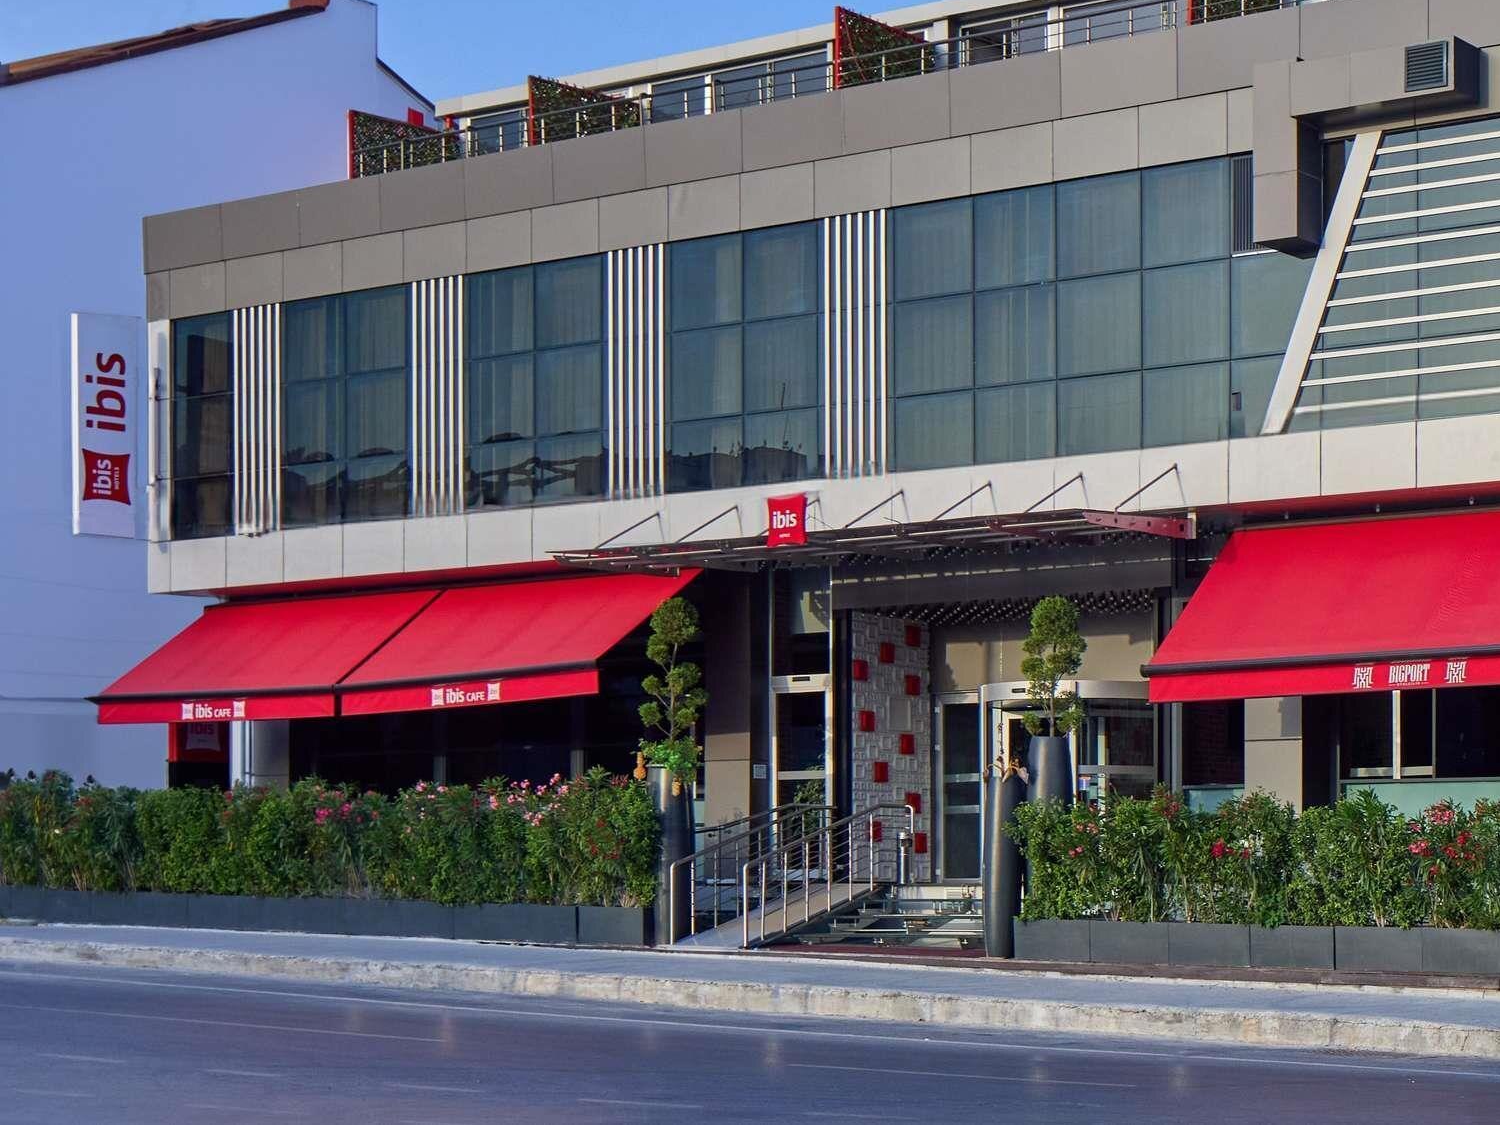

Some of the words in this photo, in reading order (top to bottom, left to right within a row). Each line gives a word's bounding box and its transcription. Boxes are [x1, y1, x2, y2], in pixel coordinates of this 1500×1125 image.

[85, 352, 126, 432] ibis
[92, 459, 112, 496] ibis
[773, 509, 797, 529] ibis
[1388, 663, 1431, 684] BIGPORT
[446, 688, 464, 704] ibis
[466, 691, 485, 702] CAFE
[195, 703, 213, 719] ibis
[214, 708, 231, 718] CAFE
